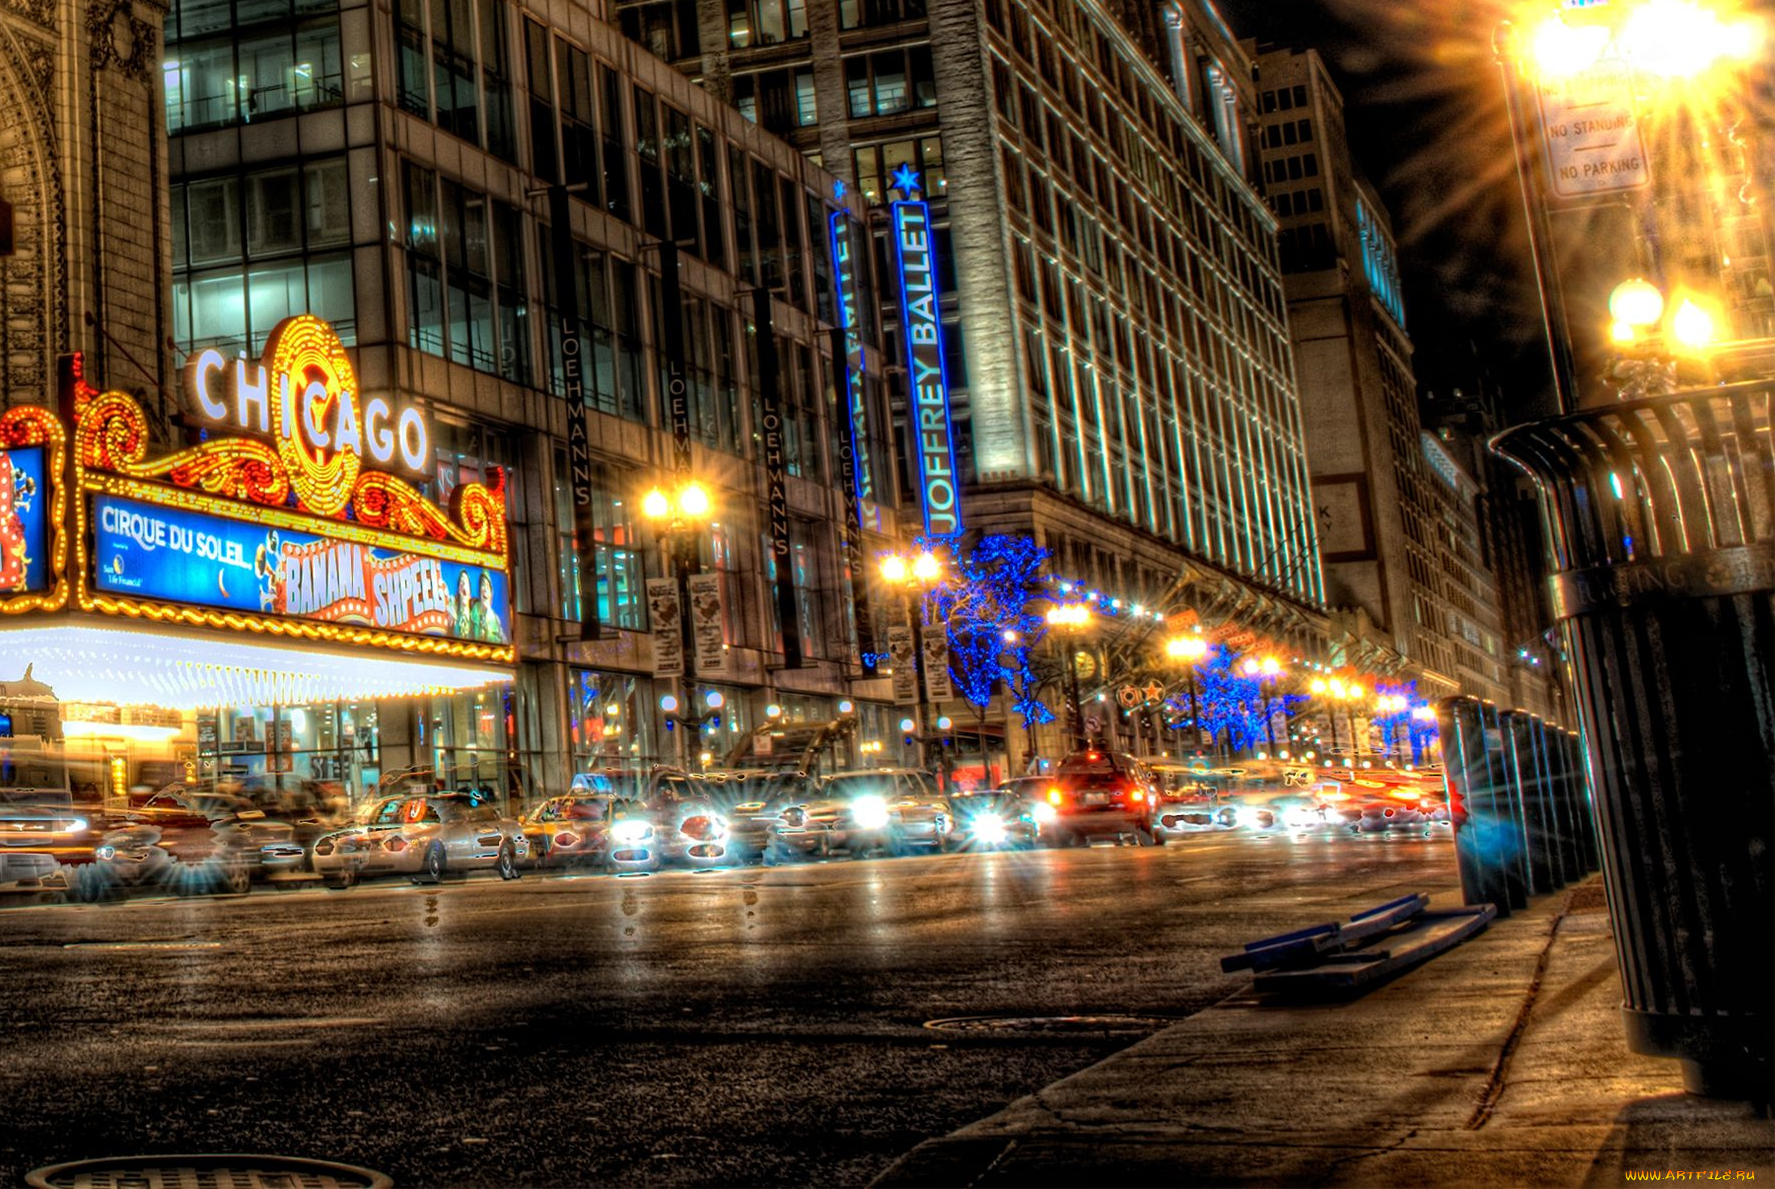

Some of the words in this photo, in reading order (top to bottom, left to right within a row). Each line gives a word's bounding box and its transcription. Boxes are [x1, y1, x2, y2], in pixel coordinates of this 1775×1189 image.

[1550, 124, 1568, 138] NO
[1573, 115, 1634, 135] STANDING
[1560, 166, 1578, 180] NO
[1583, 157, 1640, 178] PARKING
[898, 207, 938, 345] BALLET
[196, 349, 427, 470] CHICAGO
[562, 318, 590, 505] LOEHMANNS
[914, 357, 957, 531] JOFFREY
[102, 505, 167, 551] CIRQUE
[169, 524, 193, 553] DU
[763, 398, 788, 555] LOEHMANNS
[286, 543, 366, 615] BANANA
